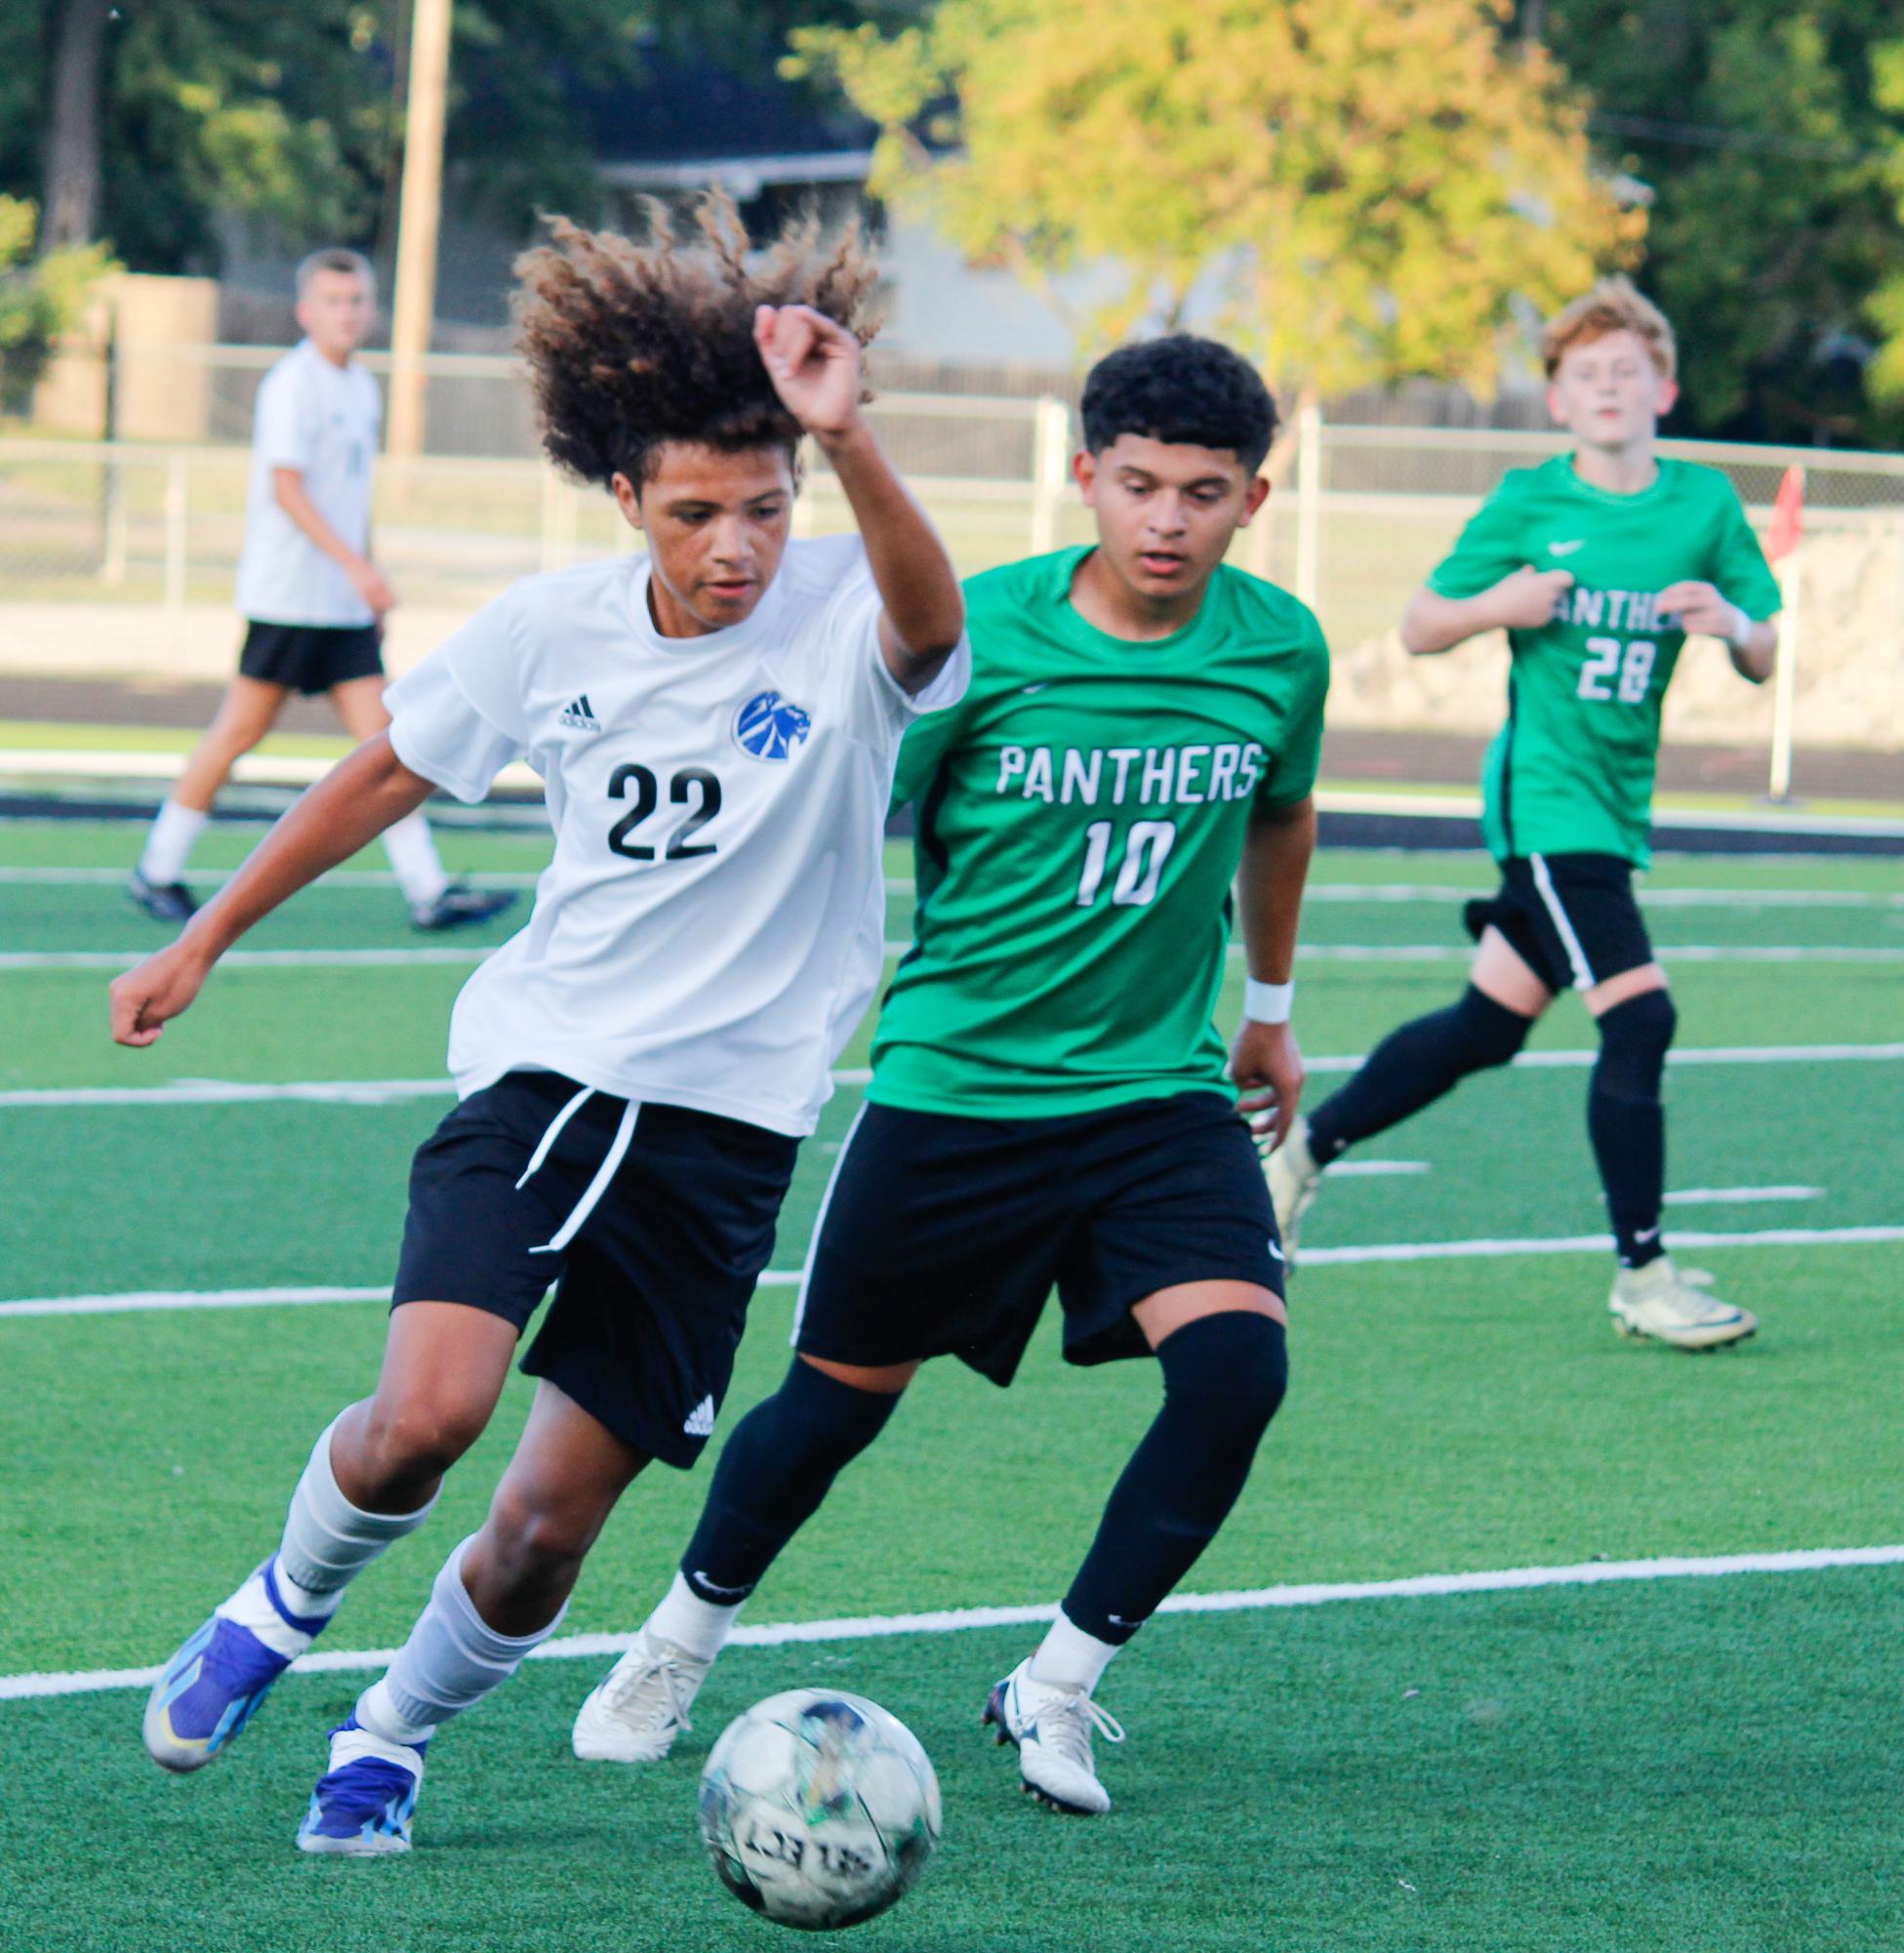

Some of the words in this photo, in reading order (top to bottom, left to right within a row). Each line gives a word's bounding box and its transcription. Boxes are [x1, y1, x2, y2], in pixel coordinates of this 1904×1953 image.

[1576, 636, 1656, 704] 28
[607, 763, 721, 860] 22
[995, 743, 1263, 805] PANTHERS
[1075, 820, 1177, 907] 10
